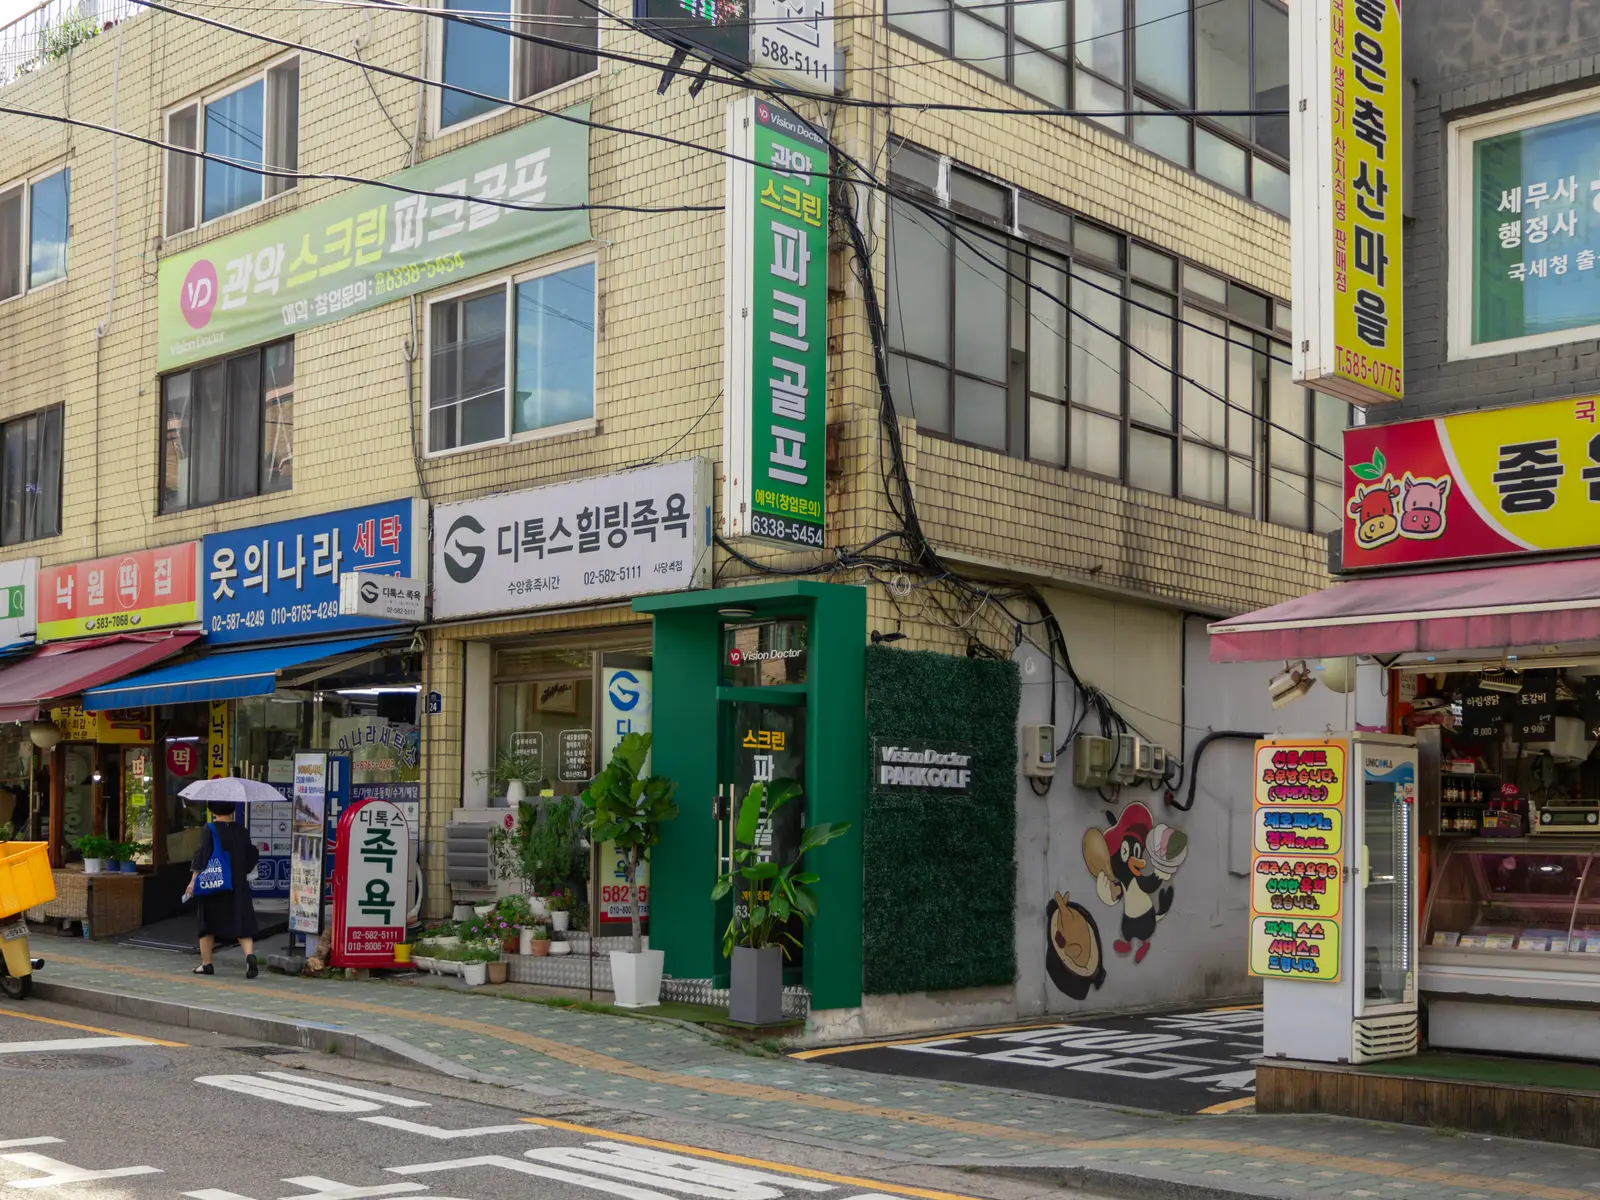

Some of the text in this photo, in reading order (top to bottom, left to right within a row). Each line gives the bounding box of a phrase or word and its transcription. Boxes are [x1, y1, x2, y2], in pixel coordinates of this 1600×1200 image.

[762, 36, 827, 82] 588-5111
[770, 115, 796, 134] Vision
[797, 123, 824, 144] Doctor
[771, 142, 813, 186] 관악
[760, 179, 821, 228] 스크린
[1497, 175, 1578, 213] 세무사
[221, 146, 552, 310] 관악 스크린 파크골프
[1498, 209, 1578, 249] 행정사
[387, 250, 464, 292] 6338-5454
[1335, 228, 1347, 293] 판매점
[1508, 249, 1600, 281] 국세청 출
[170, 330, 225, 356] Vision Doctor
[768, 220, 811, 486] 파크골프
[1492, 433, 1600, 515] 좋
[755, 488, 821, 517] 예약(창업문의)
[354, 515, 402, 558] 세탁
[752, 515, 823, 546] 6338-5454
[210, 528, 343, 601] 옷의나라
[583, 565, 642, 586] 02-582-5111
[382, 587, 421, 601] 디톡스 족욕
[96, 614, 128, 629] 583-7068
[212, 602, 338, 632] 02-587-4249 010-8765-4249
[386, 607, 416, 616] 02-582-5111
[742, 650, 769, 661] Vision
[770, 647, 802, 659] Doctor
[1521, 692, 1547, 705] 돈갈비
[212, 714, 224, 769] 낙원
[329, 726, 417, 769] 의나라세탁소
[743, 729, 785, 751] 스크린
[172, 748, 190, 772] 떡
[881, 746, 971, 766] Vision Doctor
[1271, 750, 1327, 769] 선물세트
[1268, 785, 1328, 802] (택배가능)
[360, 809, 404, 827] 디톡스
[1263, 812, 1332, 830] 제로페이로
[1266, 831, 1329, 850] 결제하세요.
[358, 828, 398, 925] 족욕
[1256, 860, 1280, 875] 매주
[199, 880, 224, 889] CAMP
[1271, 895, 1320, 910] 있습니다.
[348, 941, 400, 951] 010-8006-77
[352, 931, 398, 940] 02-582-5111
[1268, 939, 1320, 957] 서비스로
[1268, 956, 1319, 973] 드립니다.
